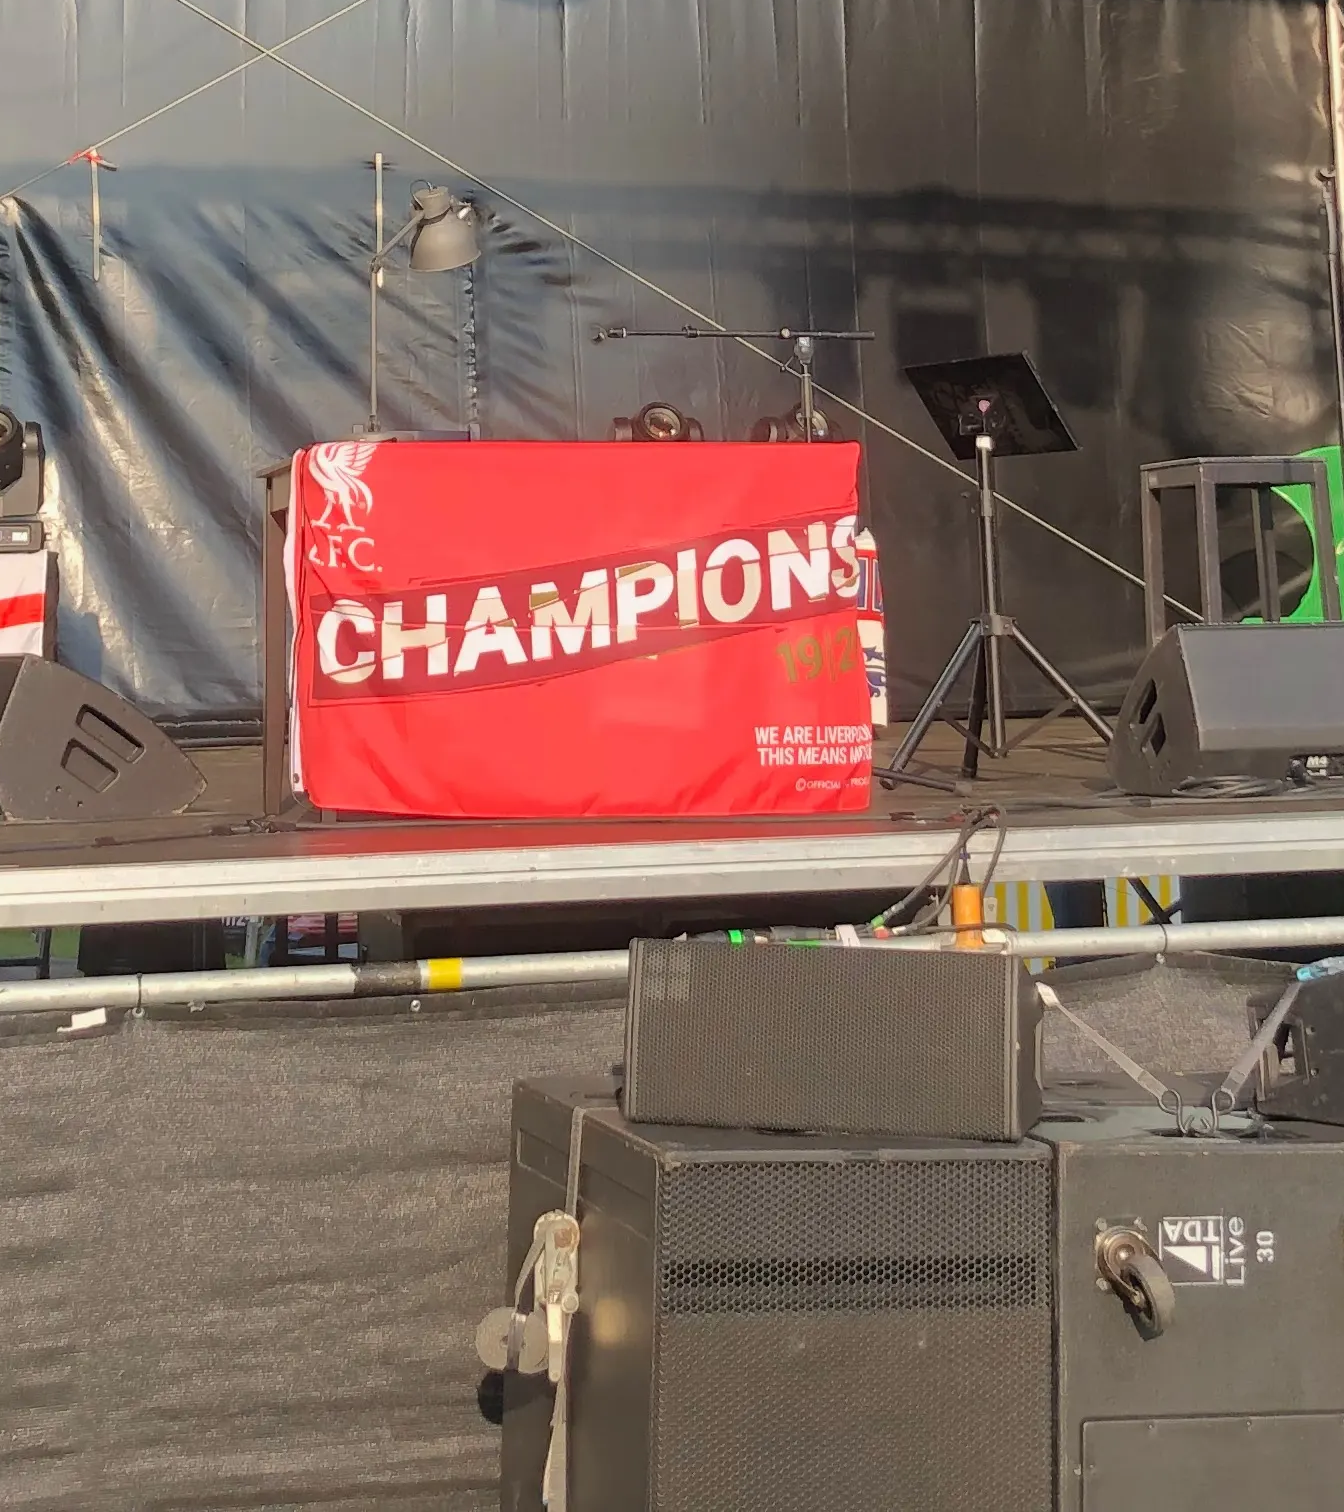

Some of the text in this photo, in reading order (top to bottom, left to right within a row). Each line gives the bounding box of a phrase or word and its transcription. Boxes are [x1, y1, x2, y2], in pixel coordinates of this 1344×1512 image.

[316, 514, 861, 685] CHAMPIONS
[754, 726, 779, 745] WE
[783, 726, 813, 744] ARE
[757, 747, 794, 766] THIS
[798, 746, 847, 765] MEANS
[1306, 755, 1327, 767] M4
[1162, 1220, 1220, 1243] TDA
[1224, 1216, 1245, 1286] Live
[1256, 1230, 1274, 1263] 30
